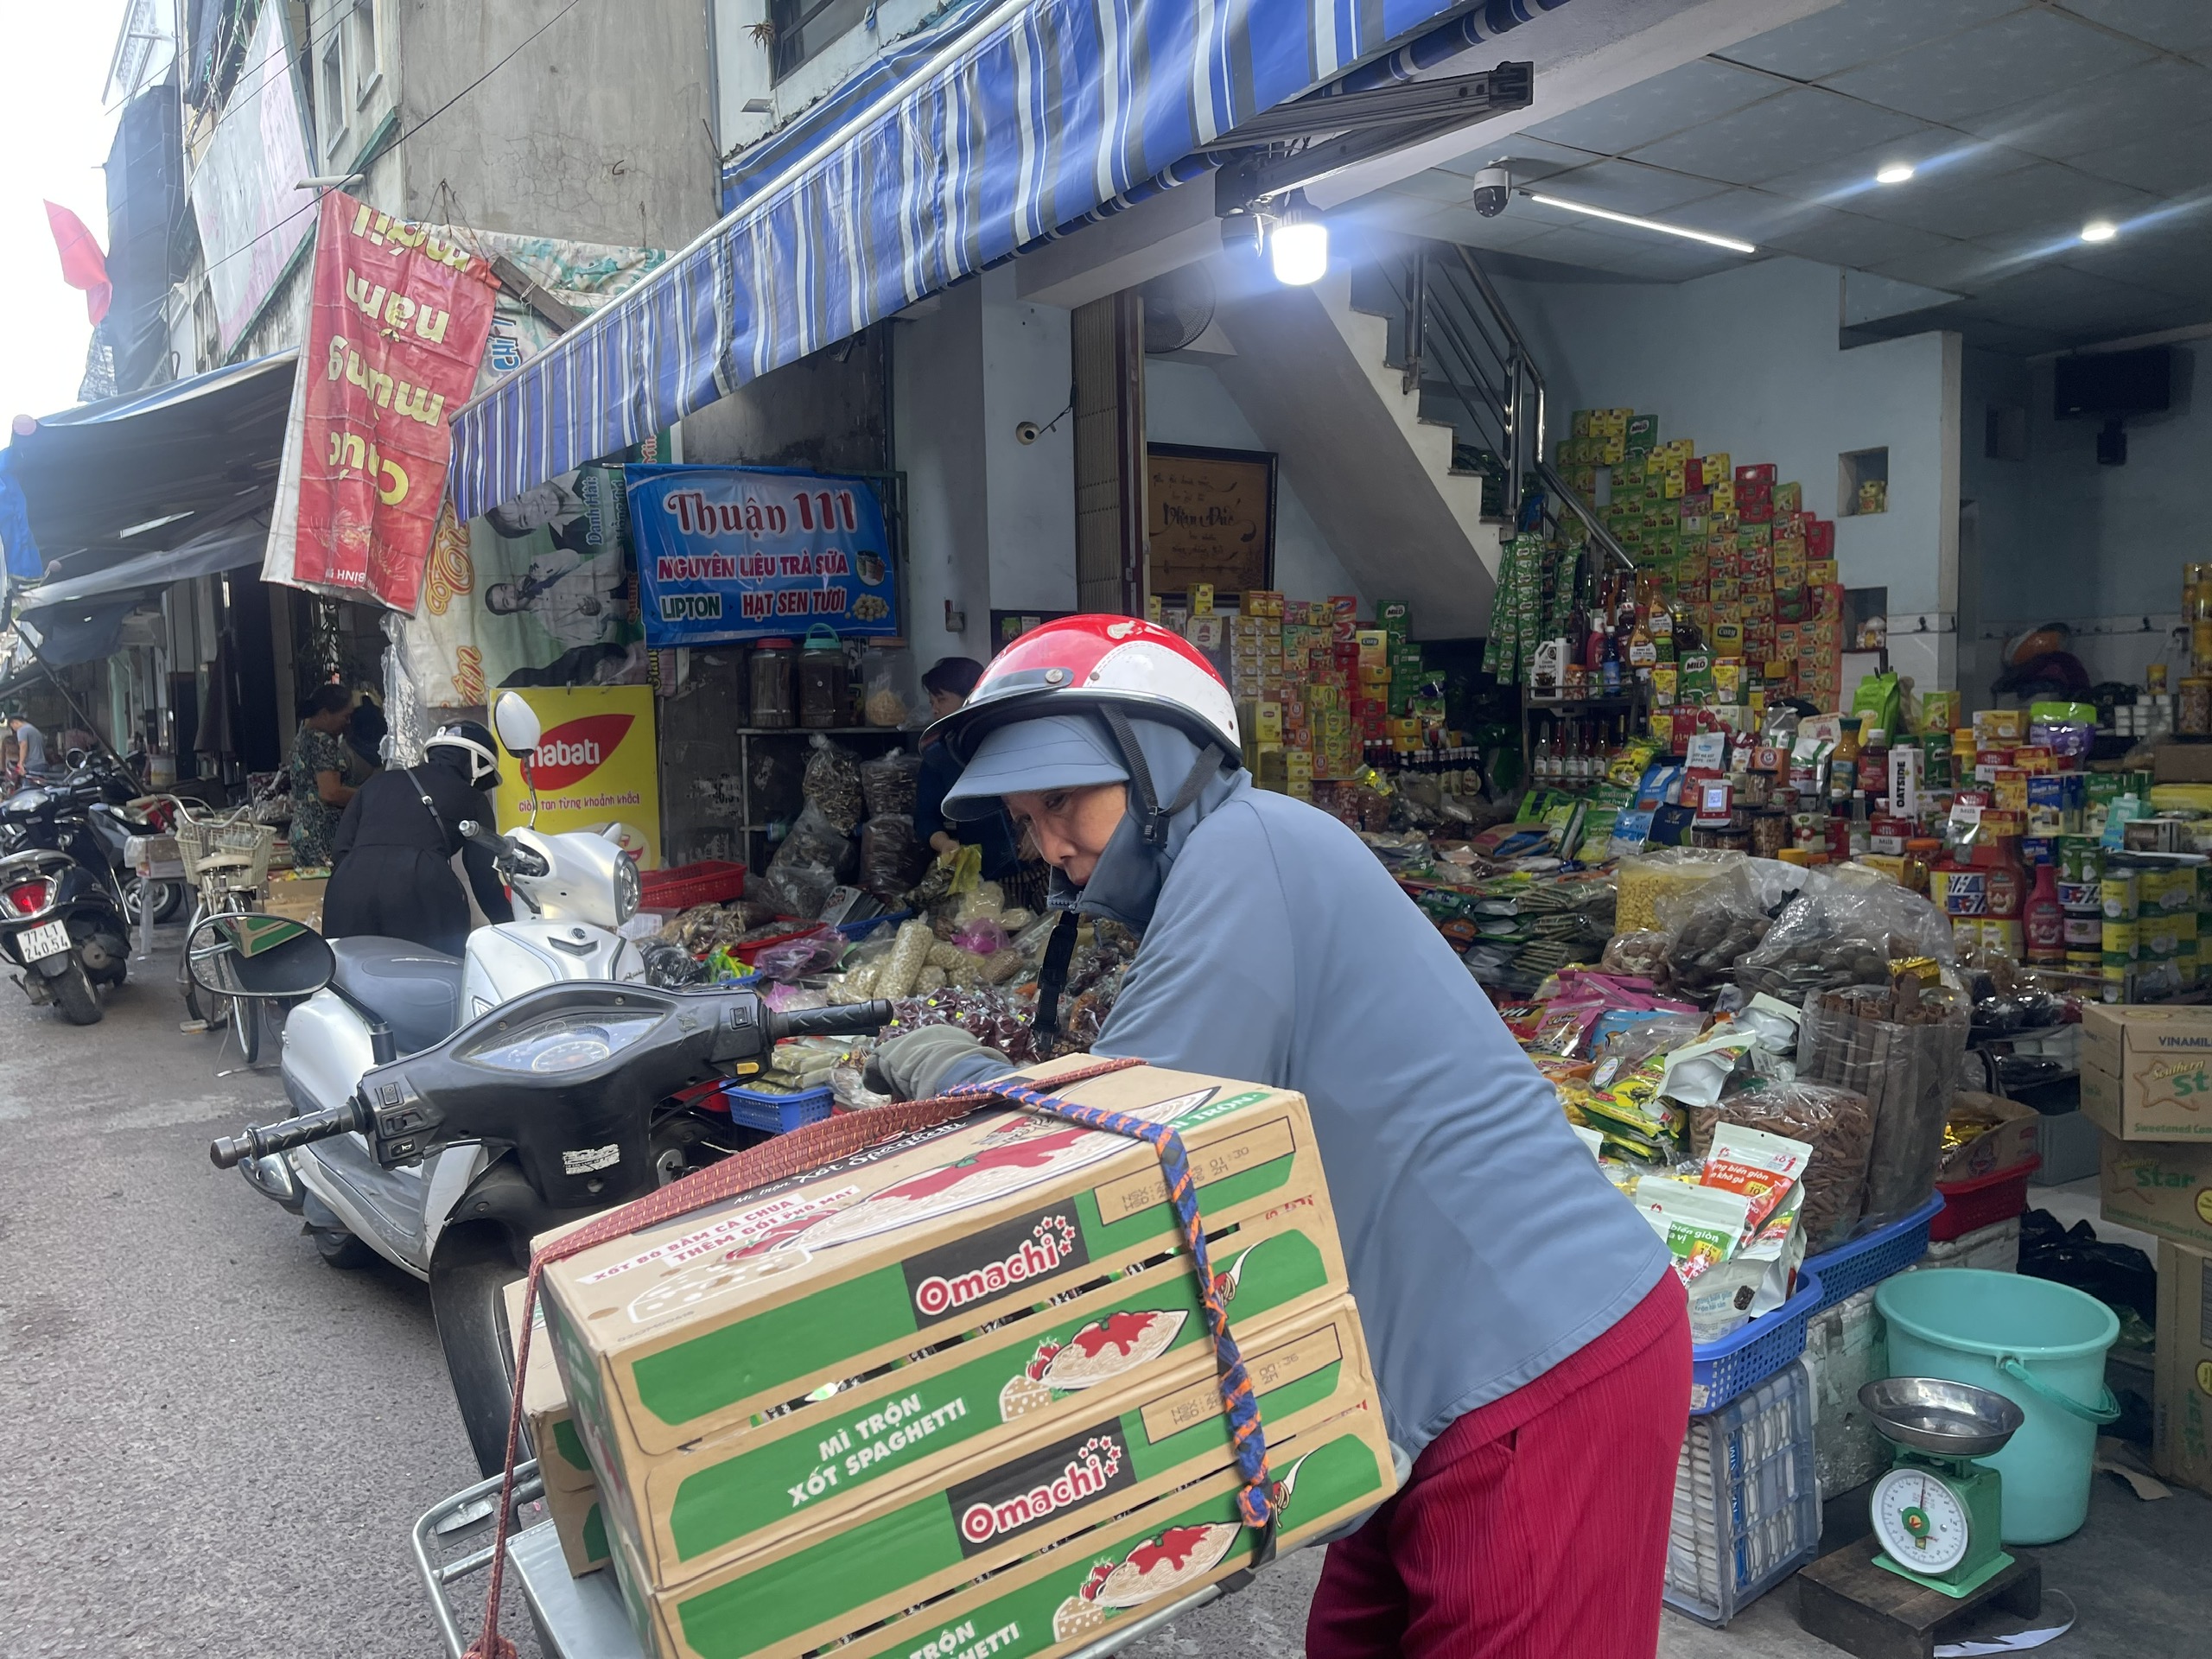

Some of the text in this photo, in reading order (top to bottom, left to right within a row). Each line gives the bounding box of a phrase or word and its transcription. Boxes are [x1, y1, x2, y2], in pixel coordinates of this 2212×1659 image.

[346, 267, 449, 344] năm
[328, 334, 445, 426] mừng
[667, 491, 855, 538] Thuận 111
[657, 548, 849, 583] NGUYÊN LIỆU TRÀ SỮA
[662, 588, 846, 621] LIPTON HẠT SEN TƯƠI
[1686, 661, 1706, 671] MILO
[541, 799, 556, 810] tan
[559, 797, 582, 810] từng
[584, 793, 614, 808] khoảnh
[1897, 761, 1906, 808] OATSIDE
[2152, 1059, 2205, 1080] Southern
[2172, 1071, 2212, 1097] St
[745, 1200, 795, 1221] CHUA
[675, 1233, 735, 1262] THÊM
[917, 1233, 1060, 1315] Omachi
[818, 1391, 922, 1461] MÌ TRỘN
[787, 1396, 967, 1508] XỐT SPAGHETTI
[963, 1453, 1107, 1543] Omachi
